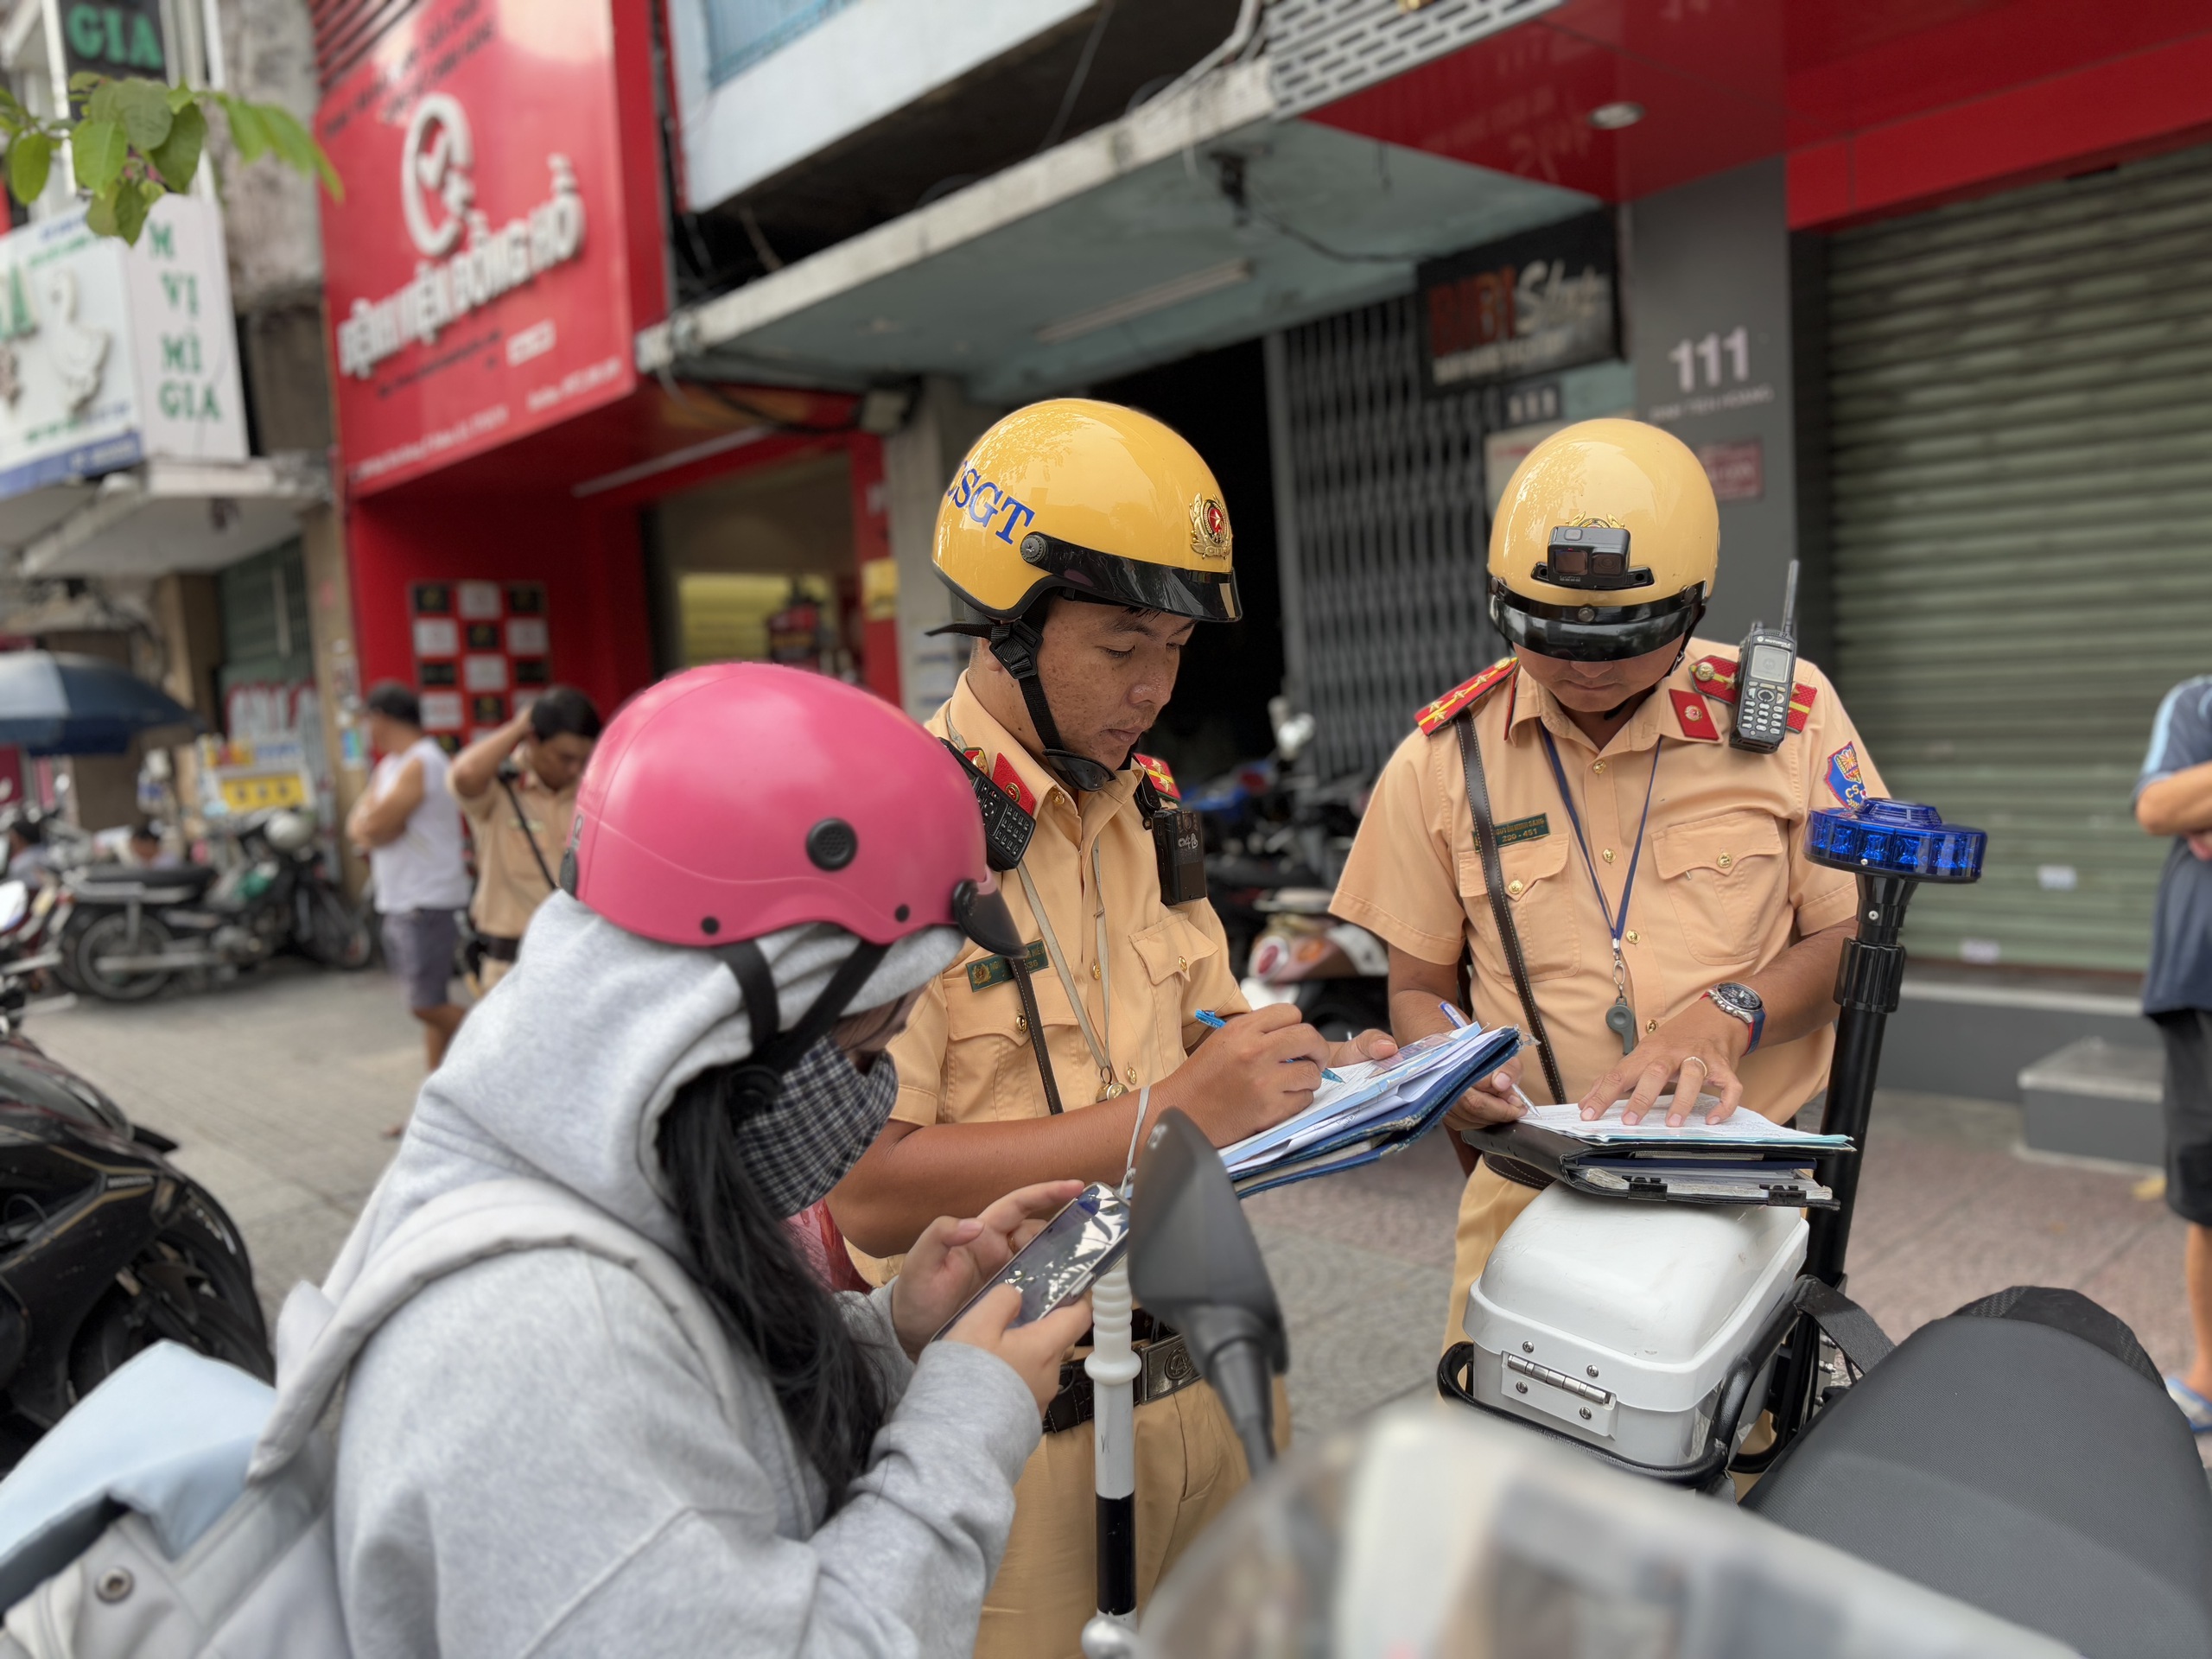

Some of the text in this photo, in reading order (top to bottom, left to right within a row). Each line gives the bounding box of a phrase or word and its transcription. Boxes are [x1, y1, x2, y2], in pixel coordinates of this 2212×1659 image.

[67, 3, 163, 69] GIA
[1669, 325, 1749, 393] 111
[159, 380, 221, 422] GIA
